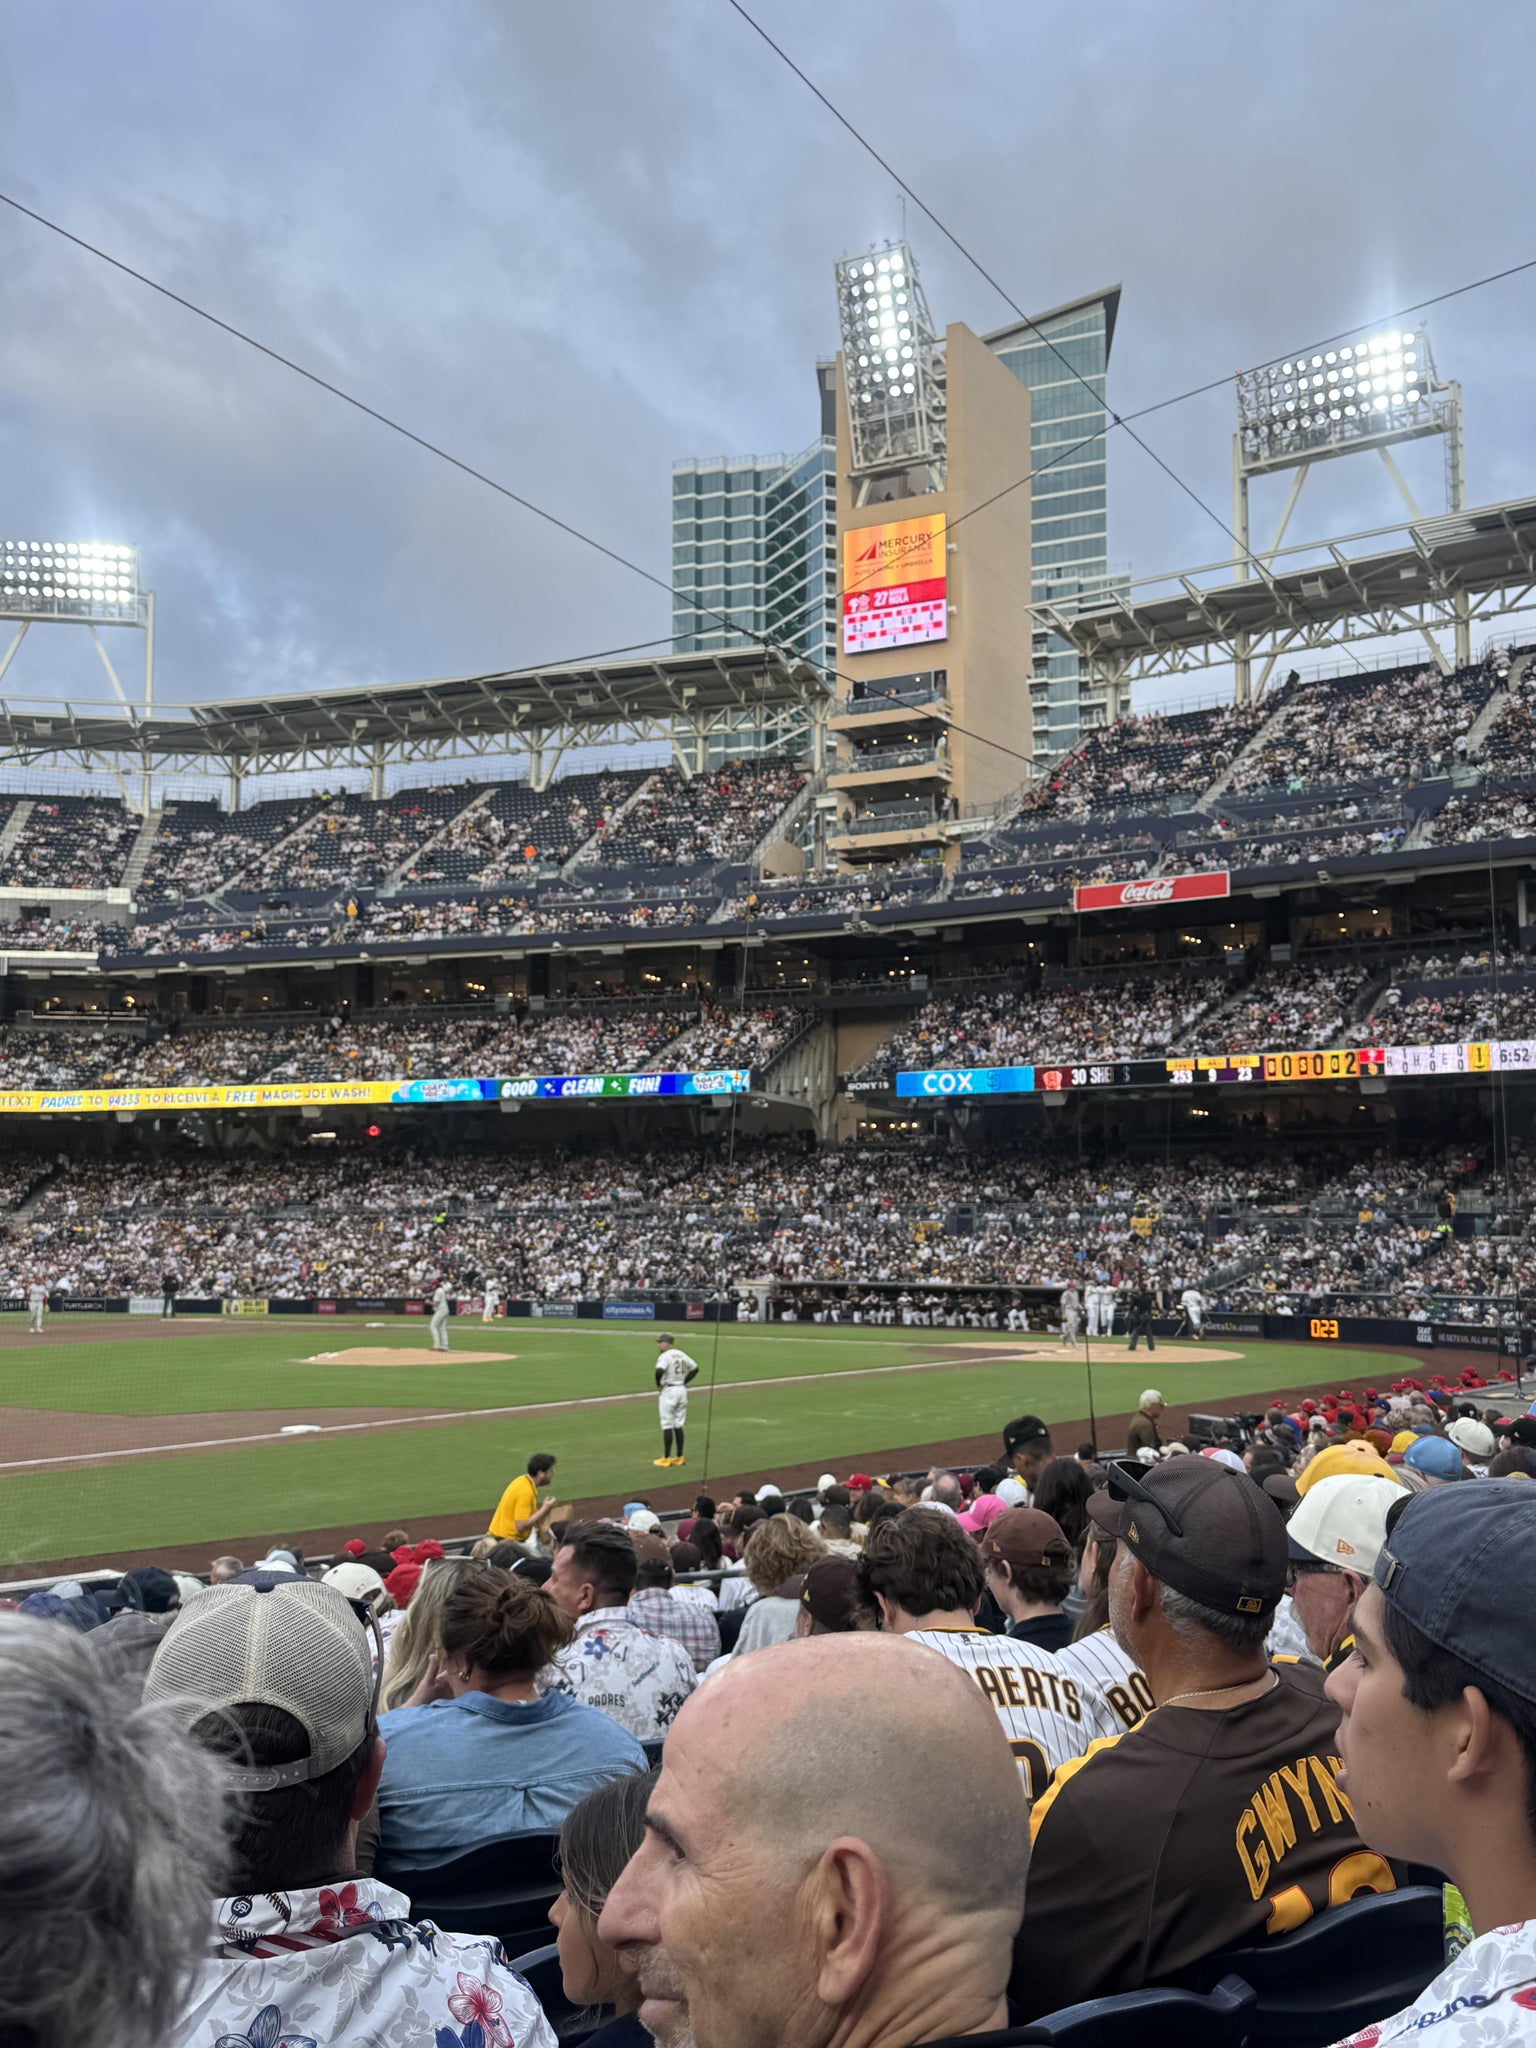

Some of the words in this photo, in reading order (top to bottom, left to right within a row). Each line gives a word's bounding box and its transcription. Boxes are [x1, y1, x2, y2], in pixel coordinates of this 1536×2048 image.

[879, 532, 932, 548] MERCURY
[879, 542, 932, 557] INSURANCE
[874, 591, 888, 607] 27
[1500, 1048, 1529, 1062] 6:52
[1282, 1055, 1292, 1076] 0
[1313, 1054, 1323, 1075] 0
[1345, 1052, 1356, 1074] 2
[1071, 1068, 1087, 1085] 30
[1238, 1067, 1252, 1081] 23
[501, 1080, 538, 1097] GOOD
[562, 1078, 605, 1095] CLEAN
[628, 1076, 661, 1093] FUN!
[847, 1082, 877, 1090] SONY
[923, 1072, 973, 1093] COX
[1, 1096, 32, 1107] TEXT
[41, 1095, 83, 1108] PADRES
[88, 1096, 102, 1105] TO
[146, 1094, 160, 1103] TO
[164, 1092, 208, 1103] RECEIVE
[226, 1090, 257, 1102] FREE
[262, 1090, 302, 1100] MAGIC
[306, 1089, 326, 1099] JOE
[330, 1088, 371, 1098] WASH!
[3, 1301, 29, 1310] SHIFT
[1310, 1319, 1339, 1338] 023
[1416, 1334, 1432, 1343] GEEK
[588, 1693, 626, 1707] PADRES
